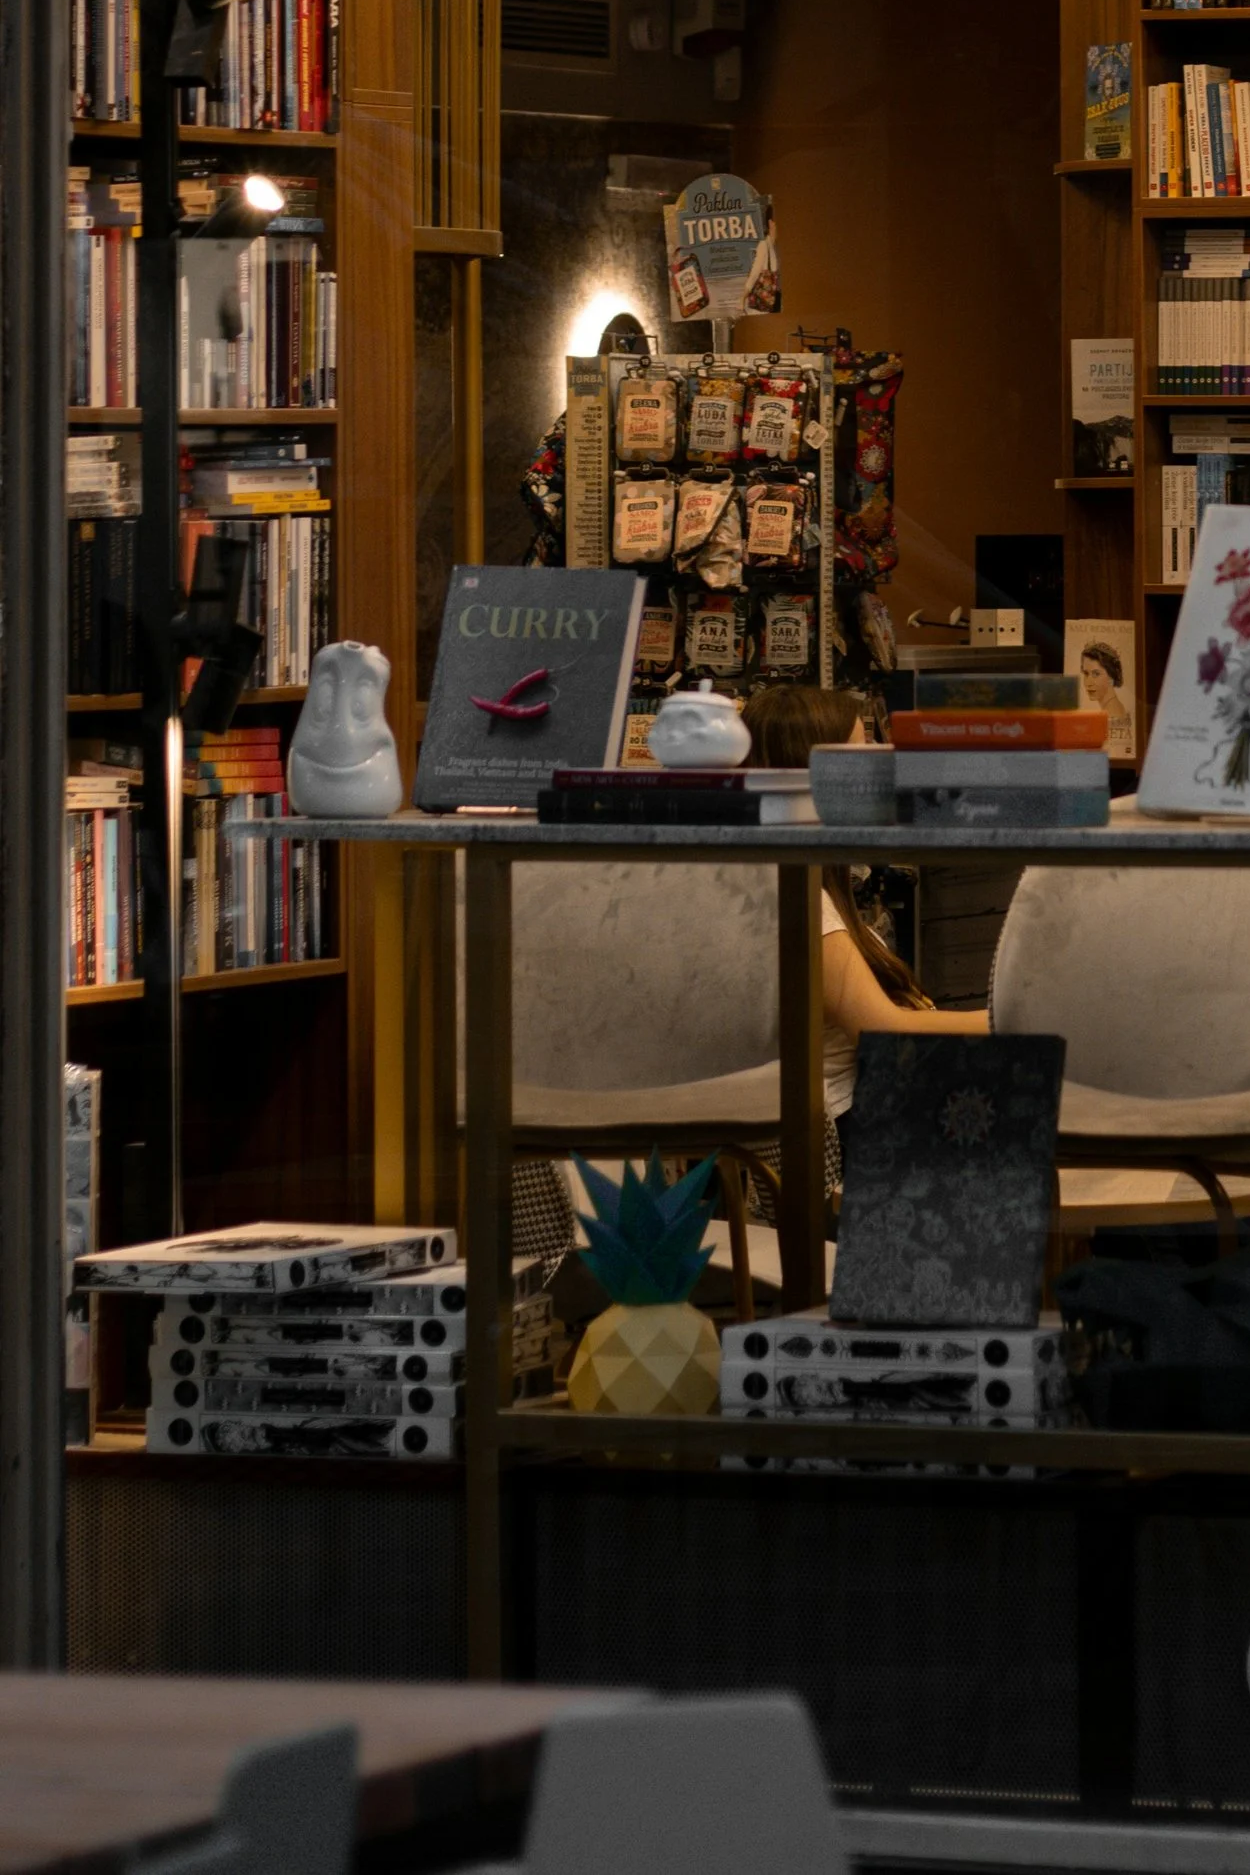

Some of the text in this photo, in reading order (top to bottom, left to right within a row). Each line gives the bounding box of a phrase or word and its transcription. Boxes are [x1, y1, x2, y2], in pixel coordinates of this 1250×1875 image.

[684, 215, 758, 244] TORBA
[459, 604, 610, 640] CURRY
[700, 626, 727, 636] ANA
[771, 627, 800, 637] SARA
[920, 721, 1025, 738] Vincent van Gogh
